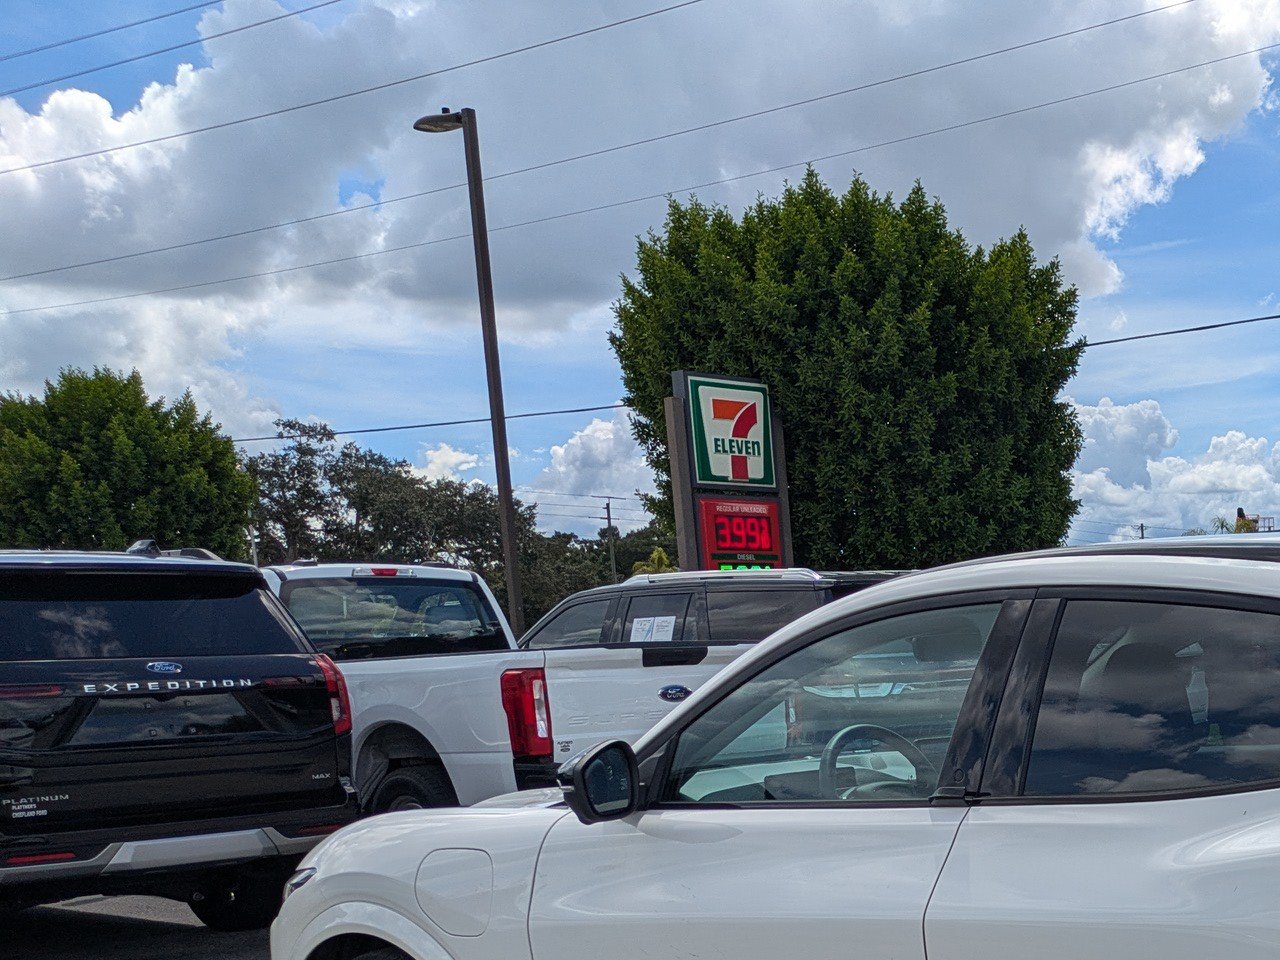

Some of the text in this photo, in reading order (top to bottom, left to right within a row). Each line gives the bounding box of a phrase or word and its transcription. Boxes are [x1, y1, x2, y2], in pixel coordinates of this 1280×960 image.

[713, 399, 757, 479] 7
[152, 662, 177, 672] Ford
[83, 679, 252, 693] EXPEDITION
[2, 794, 69, 805] PLATINUM
